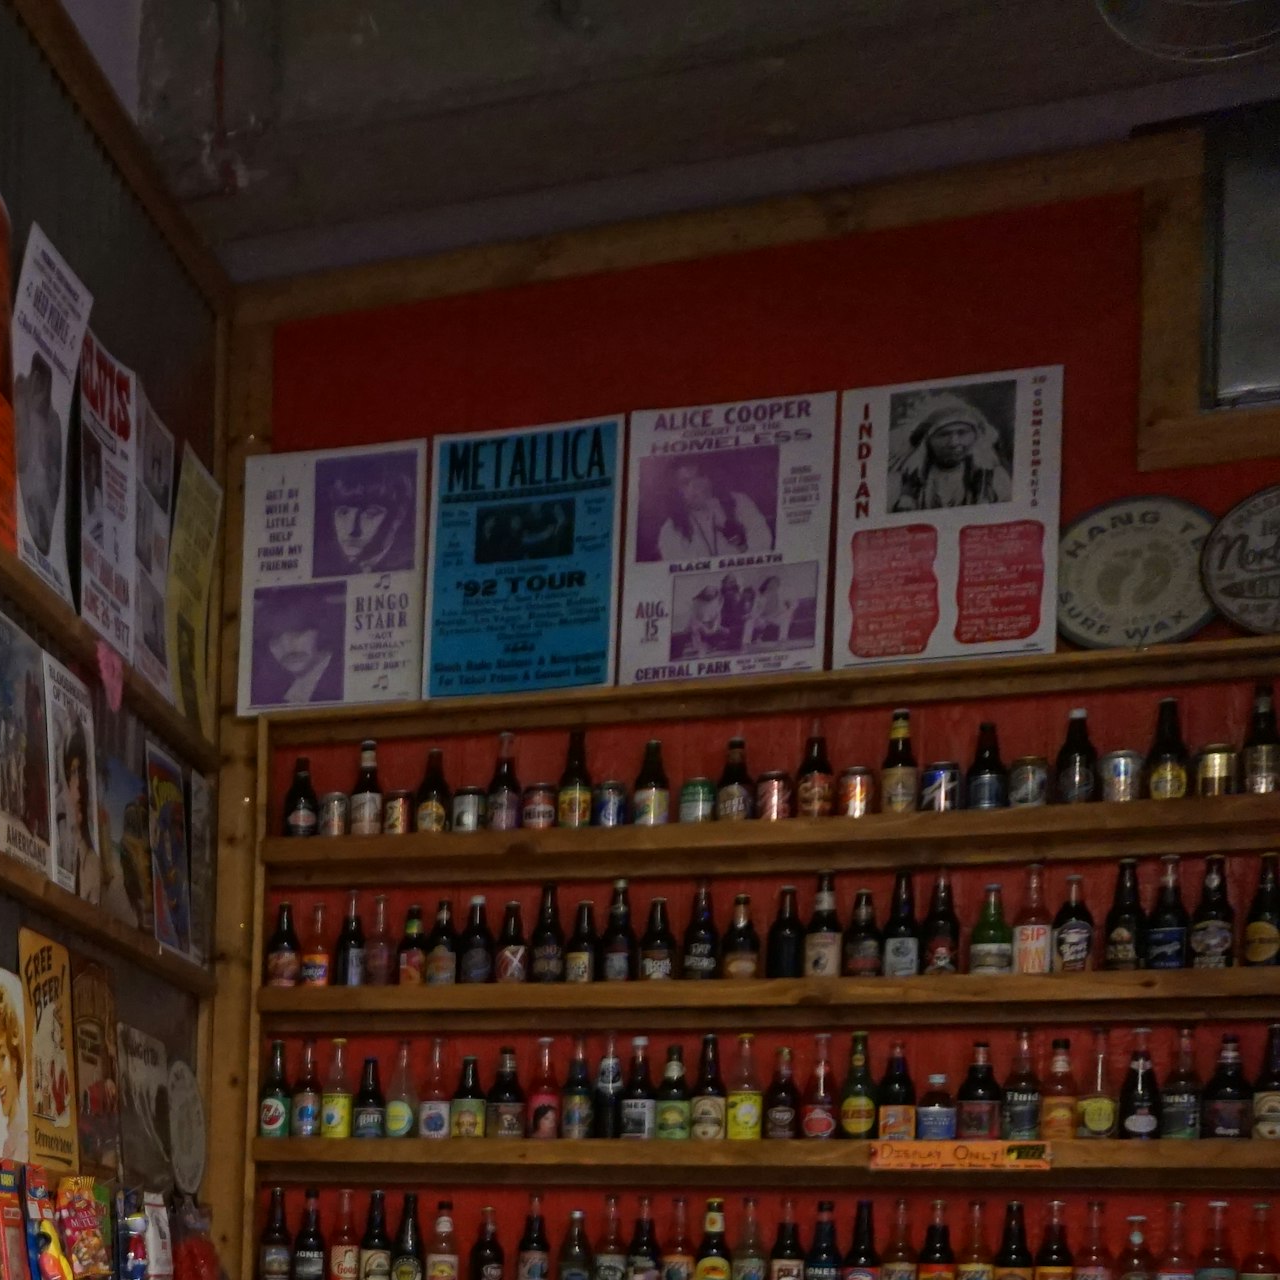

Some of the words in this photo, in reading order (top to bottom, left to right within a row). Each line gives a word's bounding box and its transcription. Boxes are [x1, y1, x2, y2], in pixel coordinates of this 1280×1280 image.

[654, 409, 713, 432] ALICE
[723, 400, 812, 426] COOPER
[447, 426, 606, 494] METALLICA
[455, 576, 498, 597] '92
[499, 570, 587, 593] TOUR
[635, 661, 693, 681] CENTRAL
[697, 660, 731, 675] PARK
